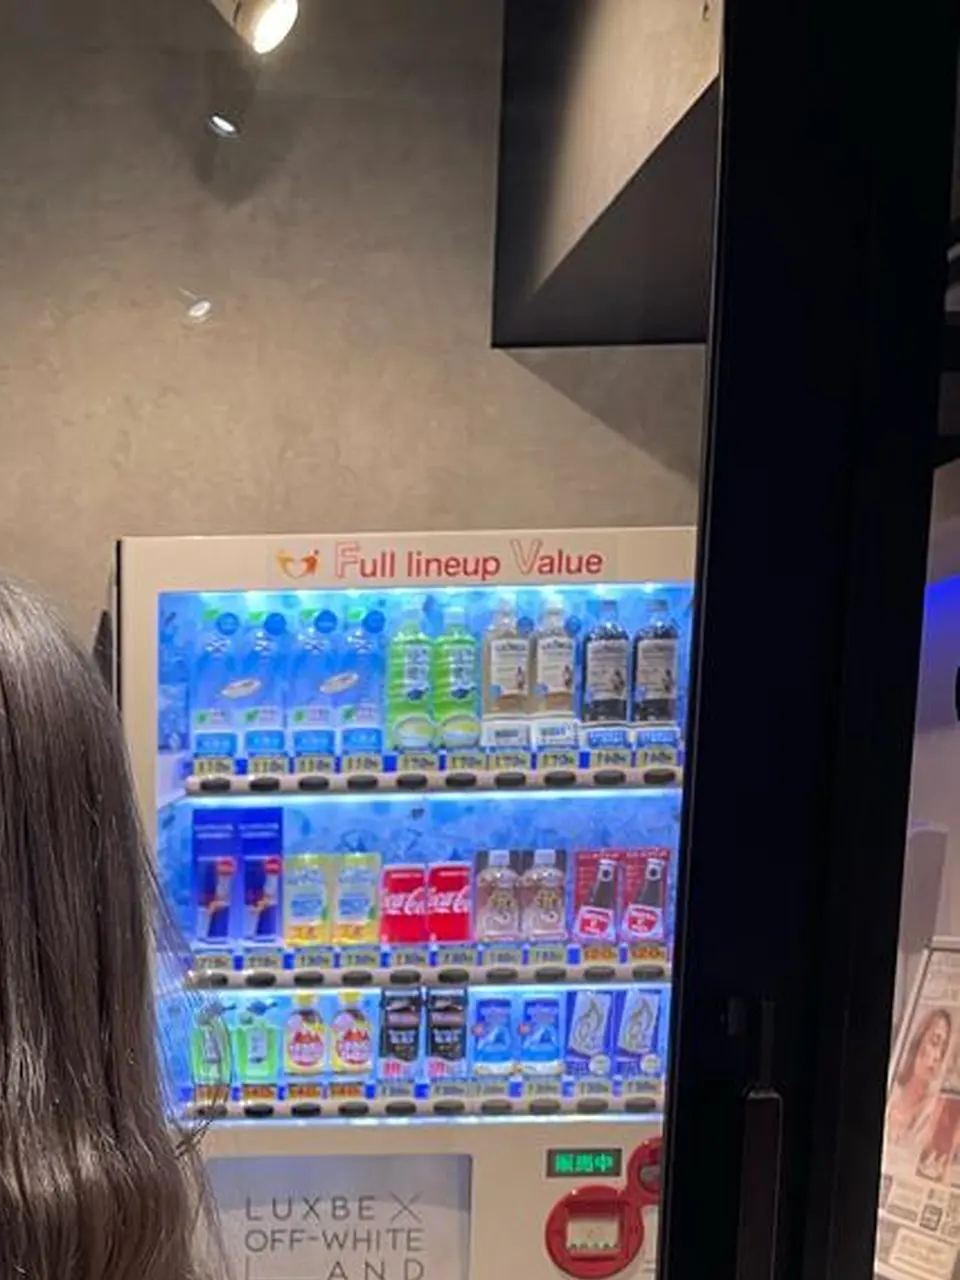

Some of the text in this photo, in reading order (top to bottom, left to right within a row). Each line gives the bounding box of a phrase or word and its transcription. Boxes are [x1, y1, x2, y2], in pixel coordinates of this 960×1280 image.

[334, 539, 603, 581] Full lineup Value
[244, 1228, 424, 1253] OFF-WHITE
